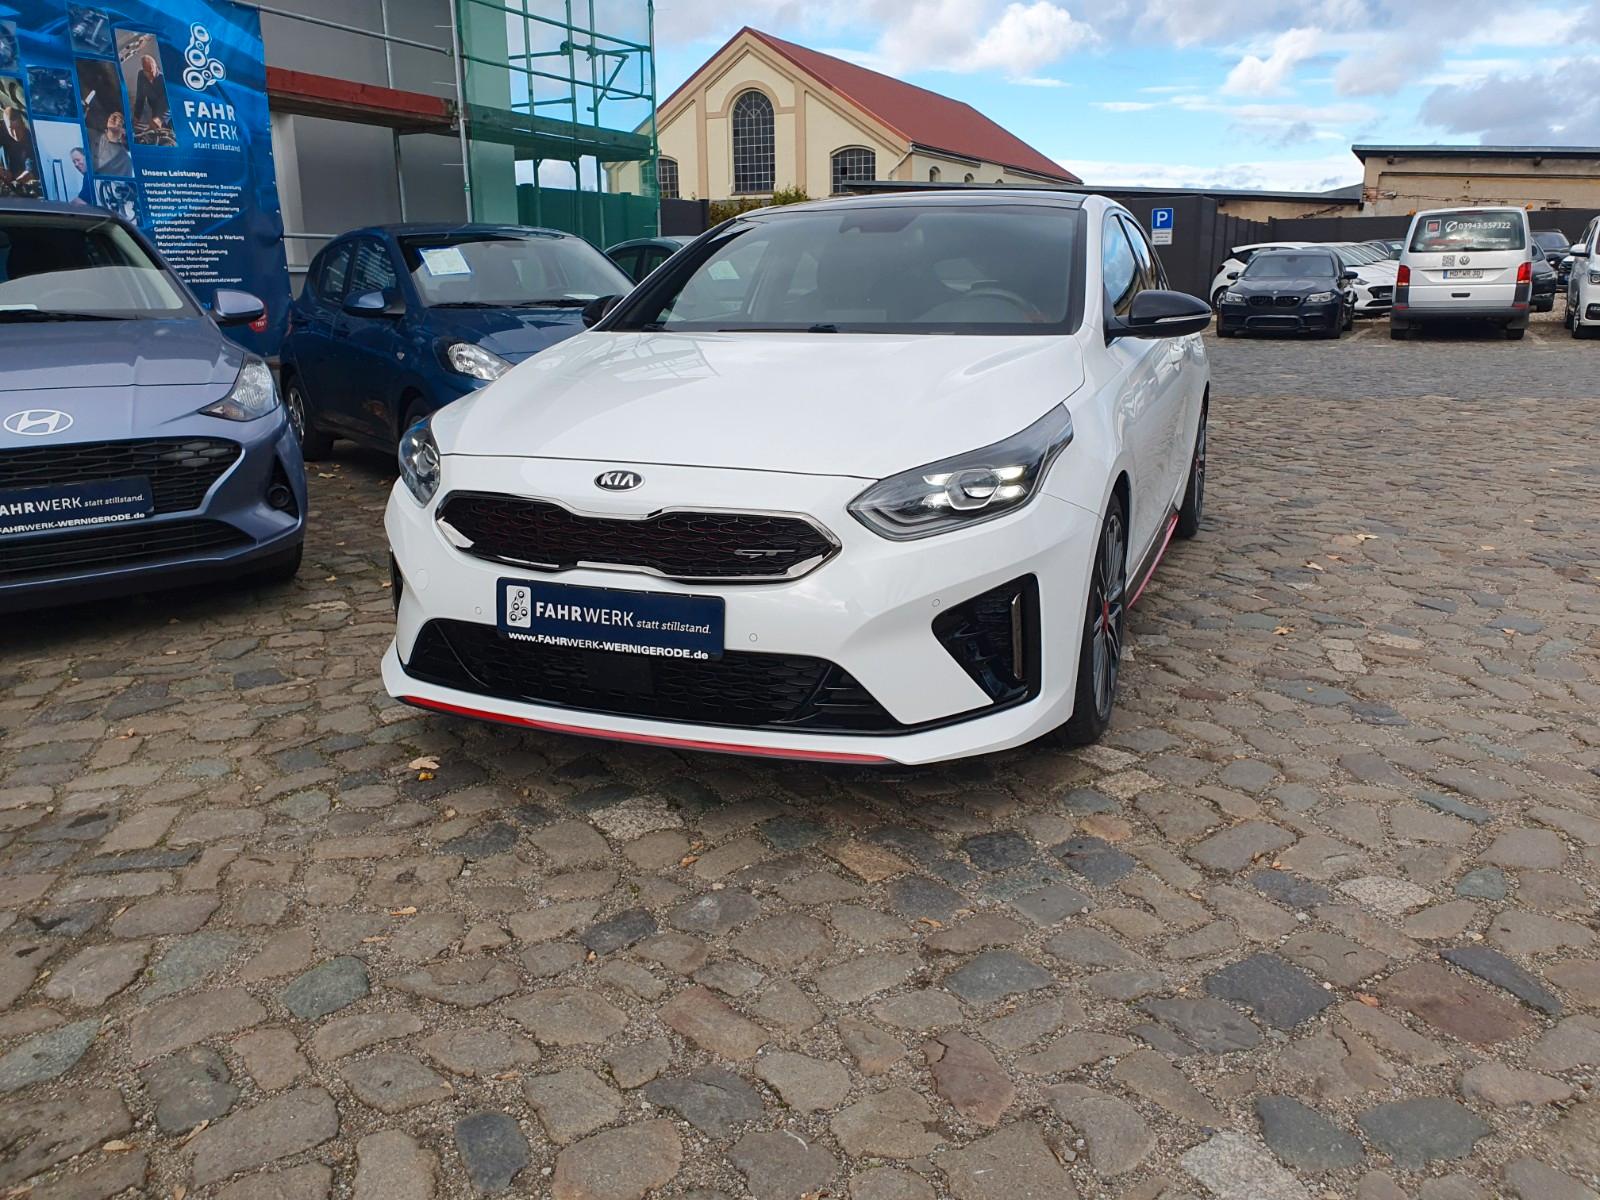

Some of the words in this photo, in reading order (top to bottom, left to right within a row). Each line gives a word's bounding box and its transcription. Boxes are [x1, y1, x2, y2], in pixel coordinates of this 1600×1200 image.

[184, 100, 236, 122] FAHR
[188, 122, 238, 142] WERK
[142, 168, 168, 176] Unsere
[169, 170, 208, 178] Leistungen
[1156, 211, 1168, 226] P
[601, 472, 634, 486] KIA
[105, 493, 145, 505] stillstand.
[0, 512, 145, 534] AHRWERK-WERNIGERODE.de
[536, 601, 634, 627] FAHRWERK
[636, 619, 659, 630] statt
[661, 621, 711, 634] stillstand.
[508, 632, 709, 660] www.FAHRWERK-WERNIGERODE.de
